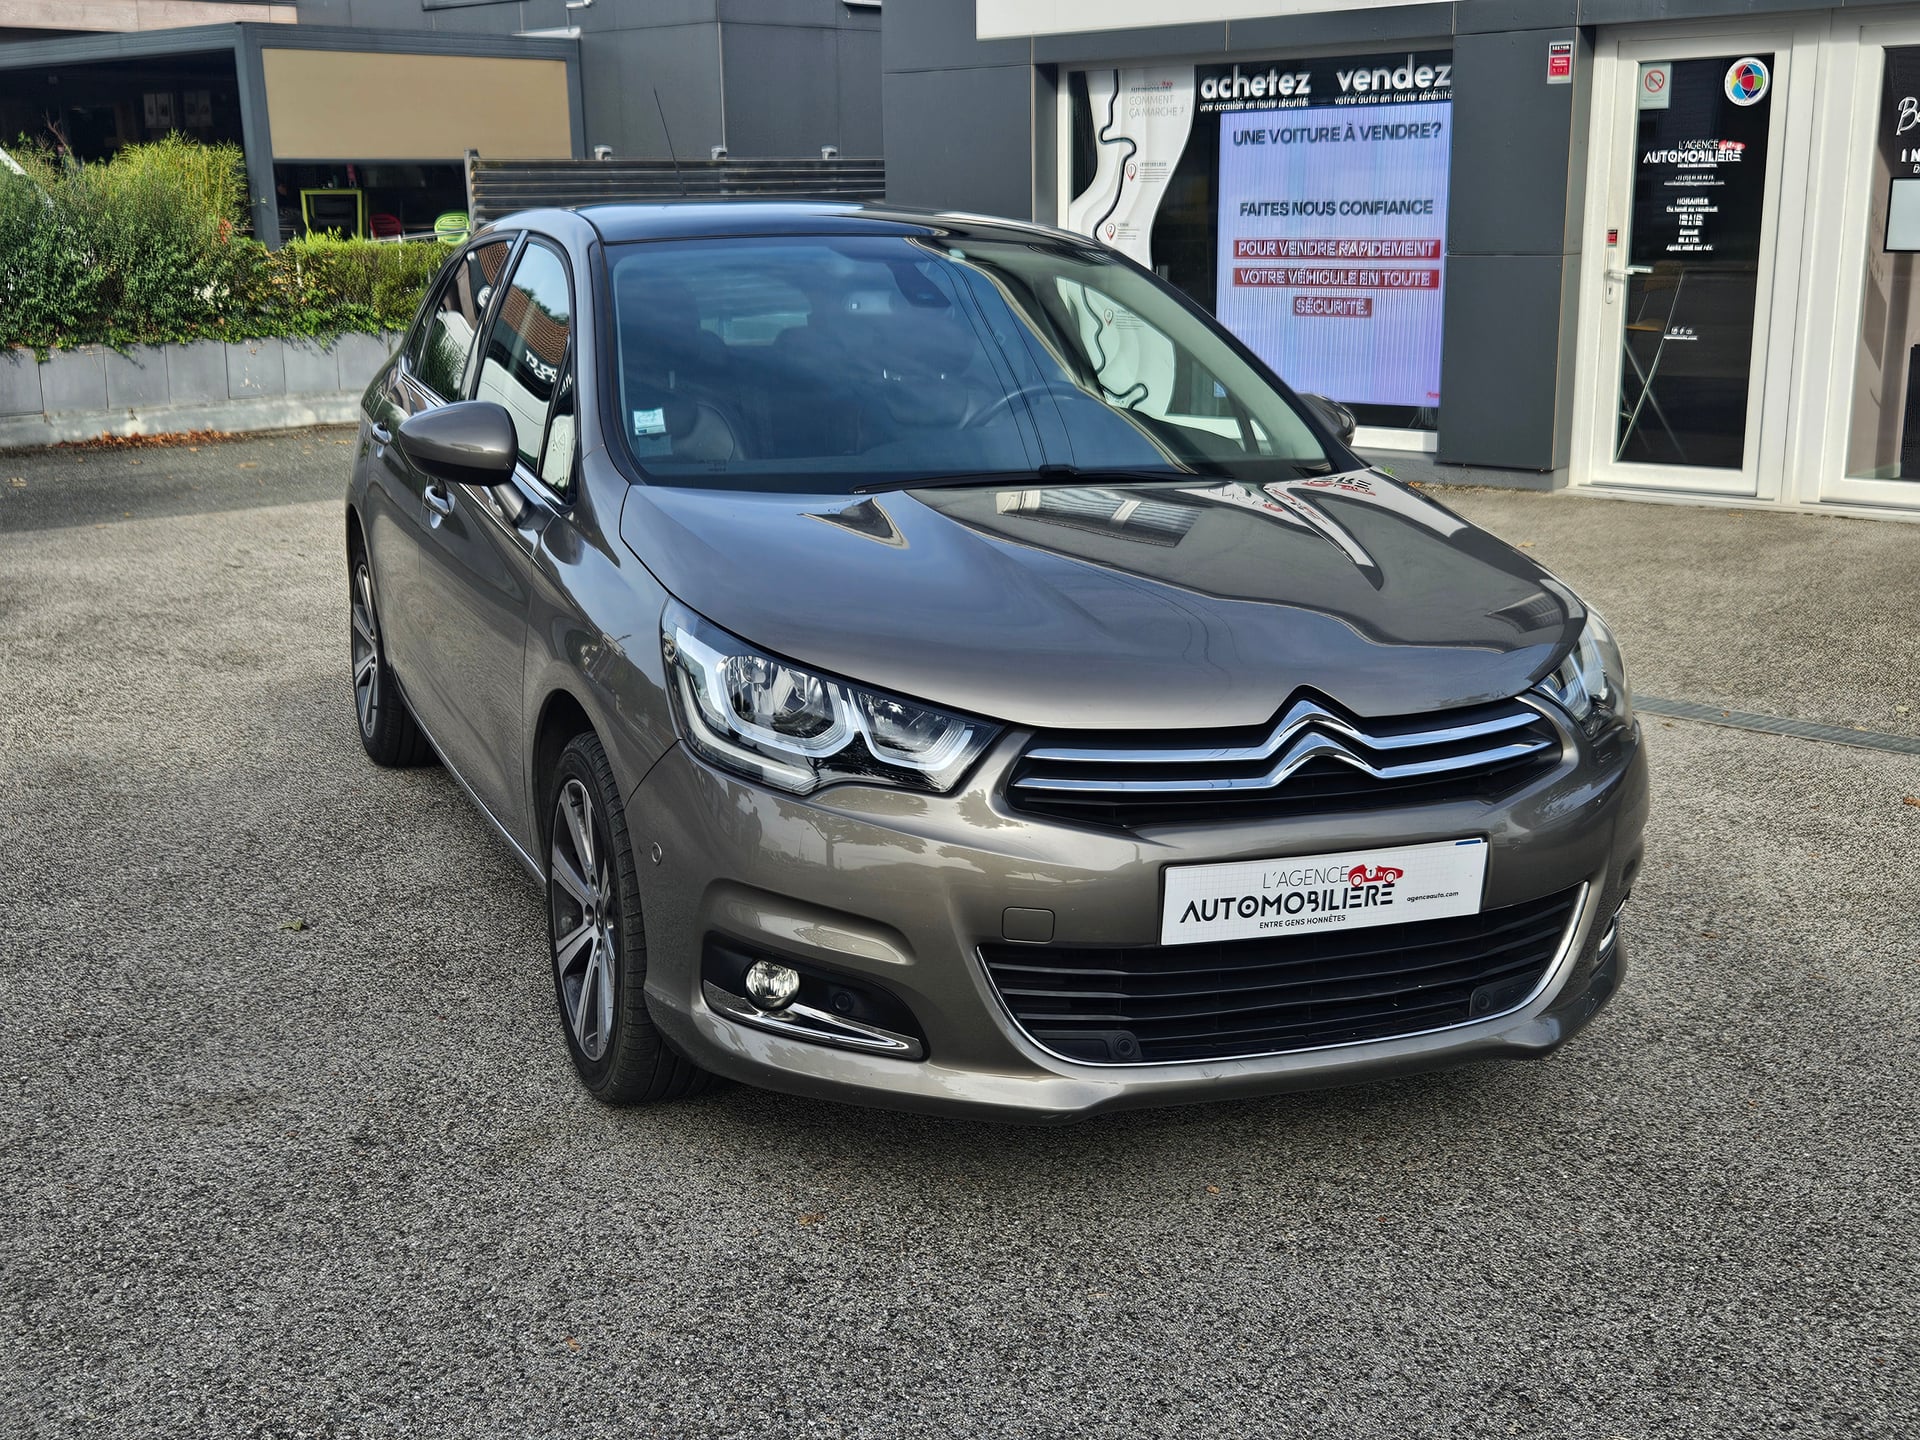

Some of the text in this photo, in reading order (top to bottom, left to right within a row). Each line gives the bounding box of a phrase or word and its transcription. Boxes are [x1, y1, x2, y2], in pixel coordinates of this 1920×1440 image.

[1200, 64, 1311, 99] achetez
[1336, 54, 1452, 92] vendez
[1129, 95, 1175, 106] COMMENT
[1200, 103, 1213, 112] une
[1214, 99, 1244, 111] occasion
[1245, 102, 1255, 110] en
[1256, 100, 1276, 109] toute
[1334, 95, 1356, 105] votre
[1358, 94, 1378, 104] auto
[1380, 94, 1390, 103] en
[1393, 92, 1416, 102] toute
[1142, 106, 1177, 118] MARCHE
[1233, 121, 1442, 146] UNE VOITURE À VENDRE?
[1643, 149, 1742, 164] AUTOMOBILIERE
[1239, 199, 1434, 217] FAITES NOUS CONFIANCE
[1238, 240, 1435, 257] POUR VENDRE RAPIDEMENT
[1240, 269, 1286, 284] VOTRE
[1359, 270, 1379, 286] EN
[1382, 271, 1430, 286] TOUTE
[1262, 865, 1350, 889] L'AGENCE
[1180, 883, 1459, 923] AUTOMOBILIERE agenceauto.com
[1259, 914, 1346, 929] ENTRE GENS HONNÊTES
